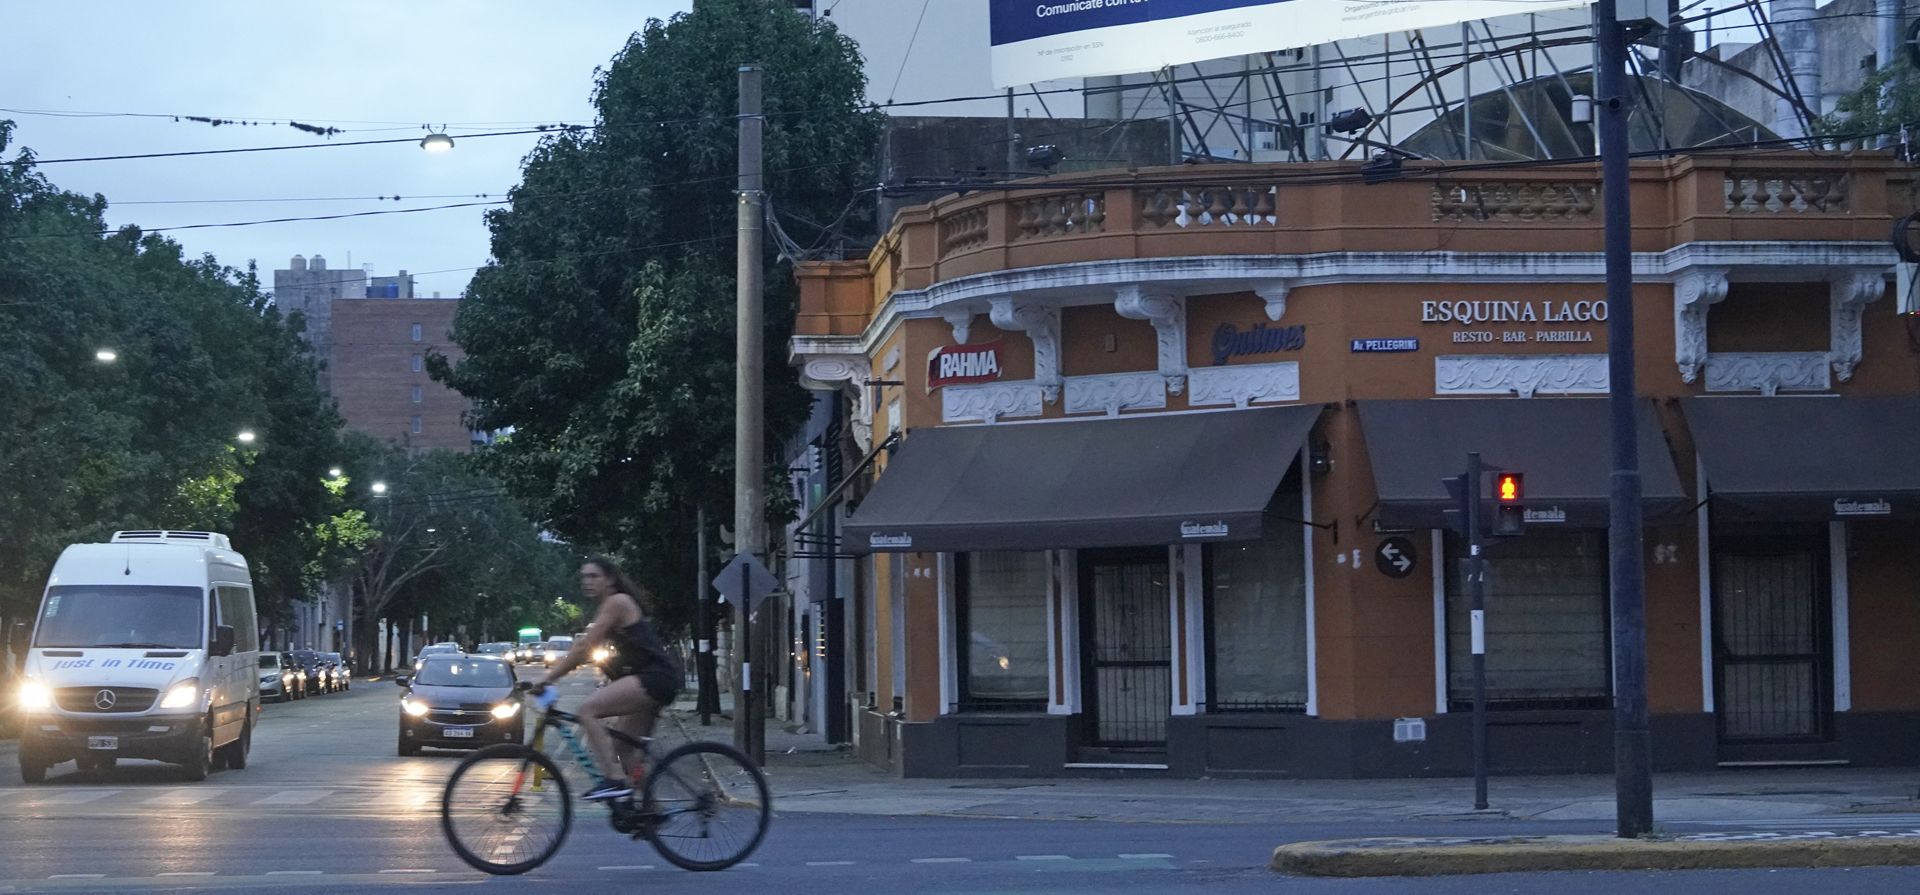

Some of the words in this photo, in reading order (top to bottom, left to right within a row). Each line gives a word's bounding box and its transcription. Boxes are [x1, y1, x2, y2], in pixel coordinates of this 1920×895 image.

[1036, 0, 1103, 17] Comunicate
[1421, 300, 1538, 324] ESQUINA
[1211, 322, 1306, 365] Quilmes
[1452, 331, 1493, 343] RESTO
[1502, 331, 1526, 342] BAR
[1536, 331, 1592, 342] PARRILLA
[1834, 498, 1891, 513] Guatemala
[1180, 520, 1229, 536] Guatemala
[869, 531, 913, 545] Guatemala
